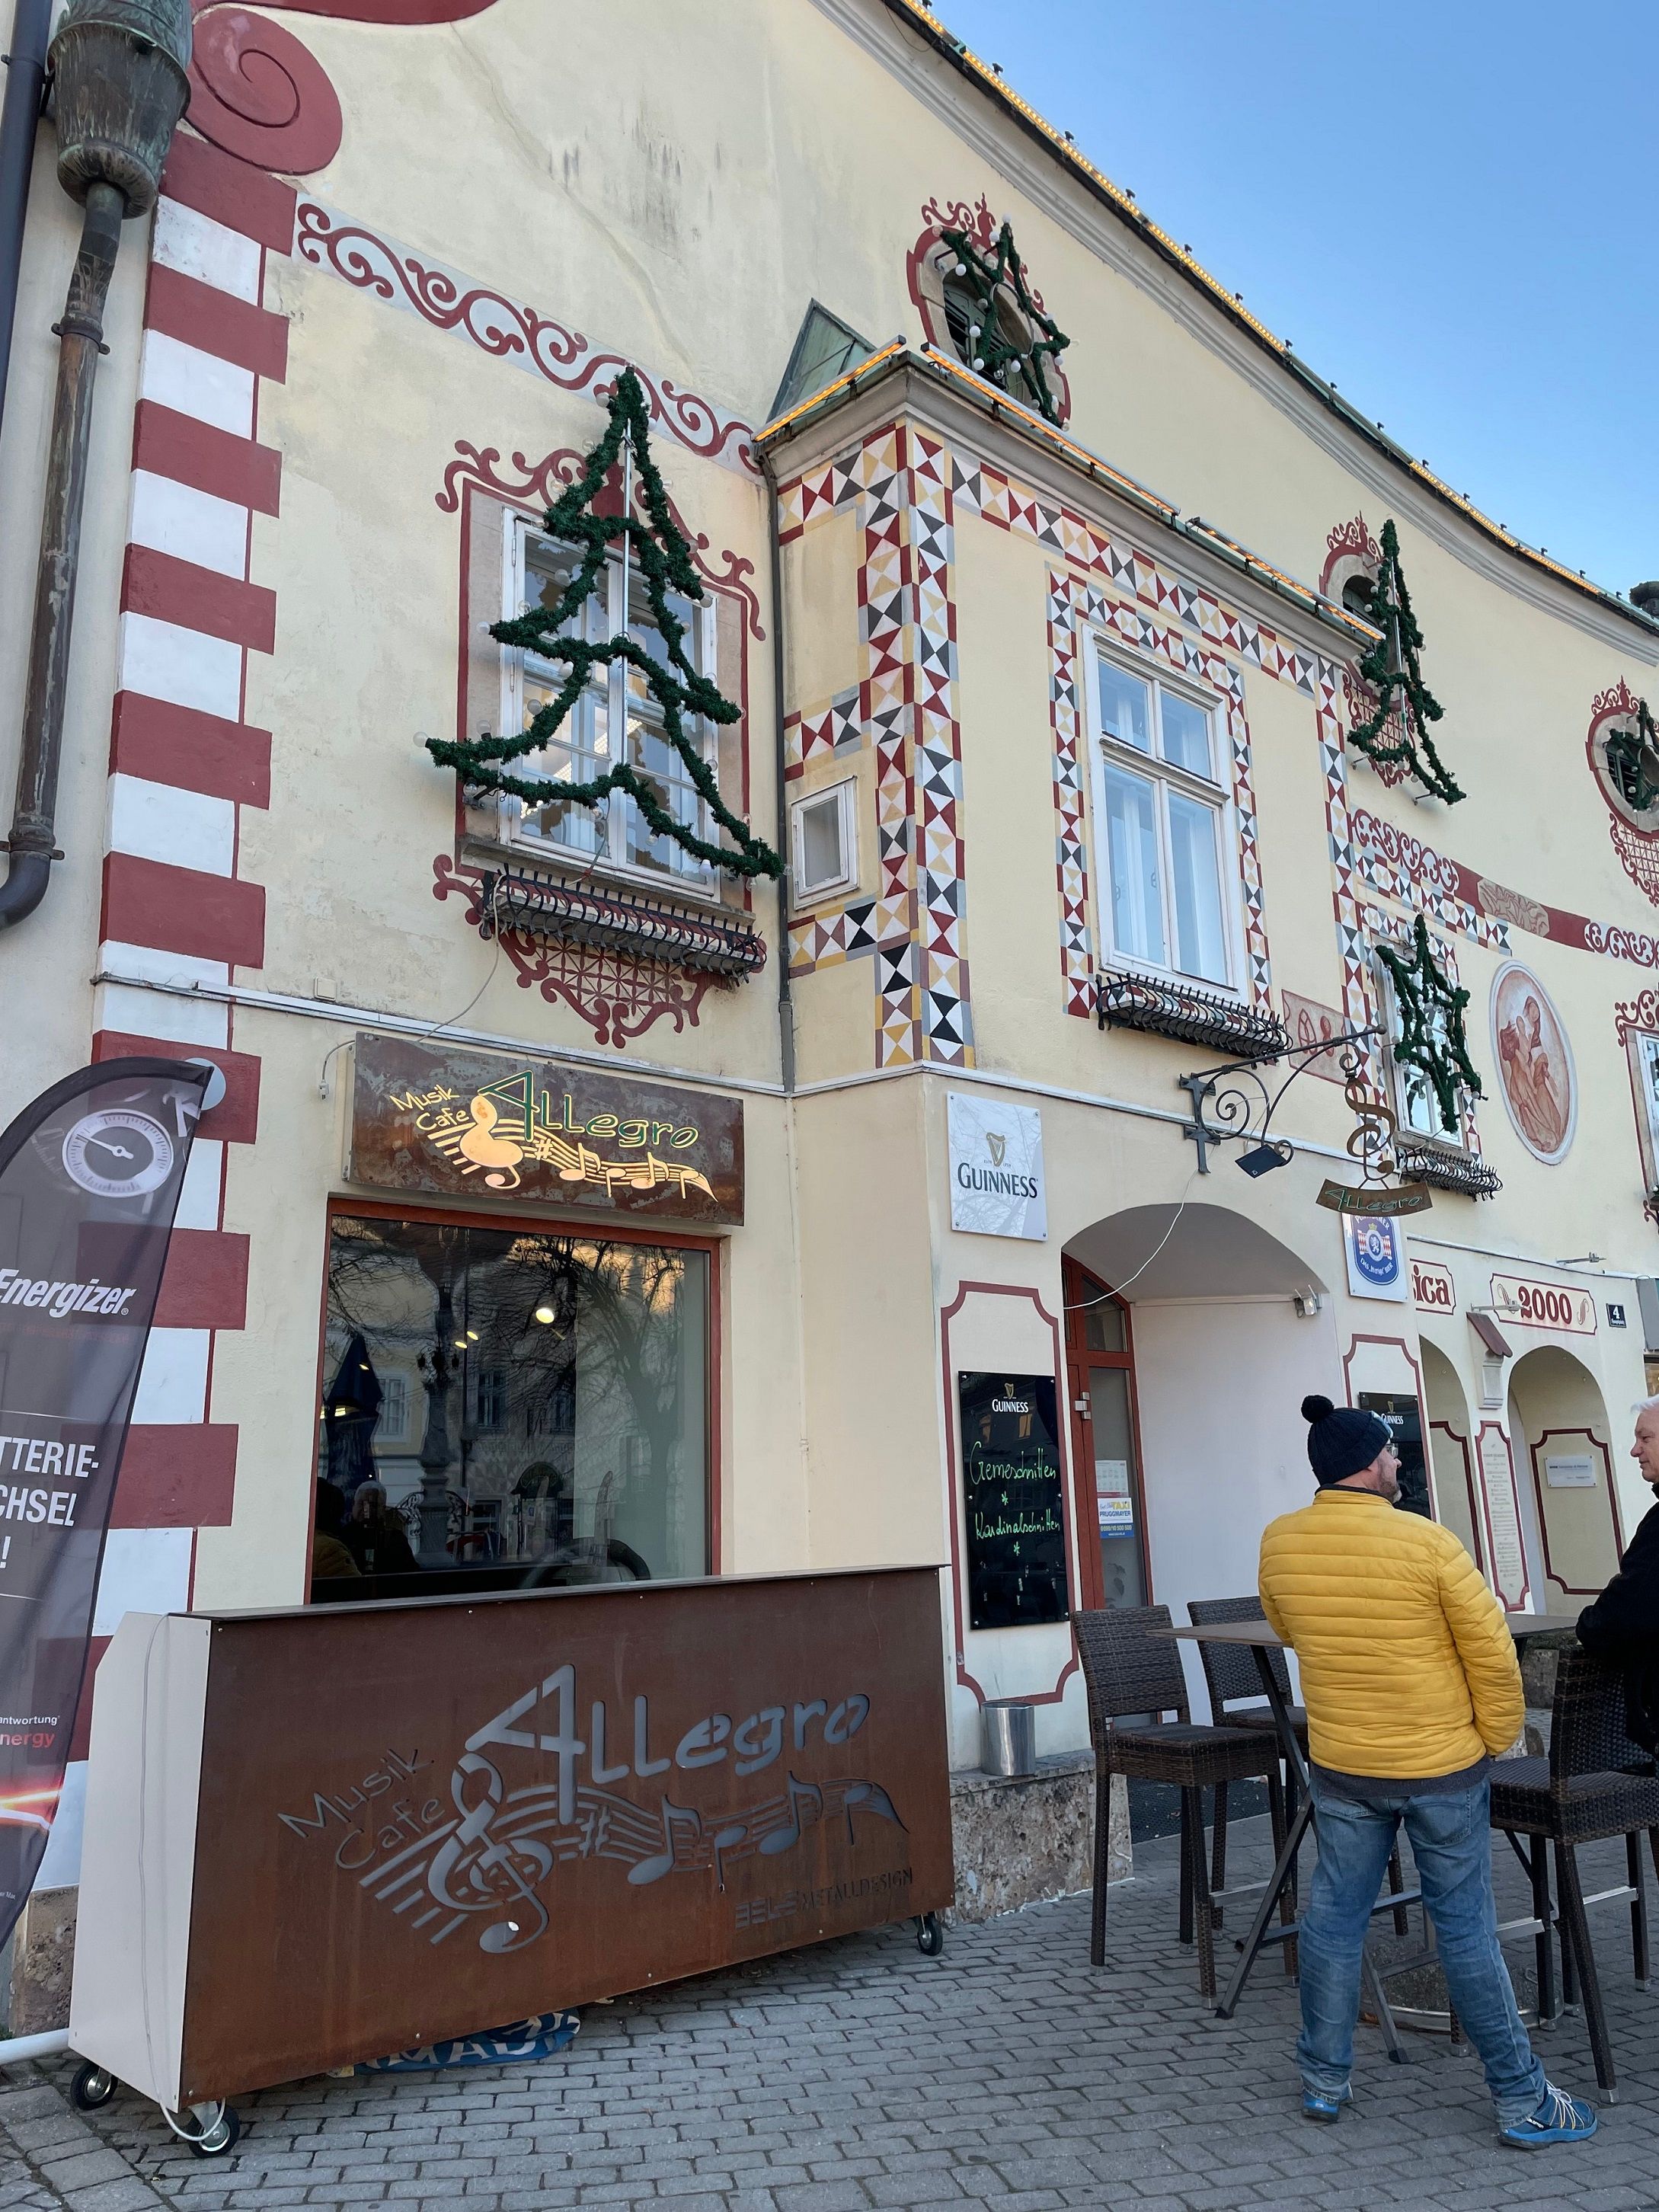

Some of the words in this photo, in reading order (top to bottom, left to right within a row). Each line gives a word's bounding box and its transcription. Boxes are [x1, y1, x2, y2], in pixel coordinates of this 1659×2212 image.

[389, 1084, 460, 1111] Musik
[416, 1108, 469, 1131] Cafe
[957, 1162, 1037, 1198] GUINNESS
[0, 1268, 137, 1319] Energizer
[1411, 1264, 1451, 1306] ica
[1518, 1286, 1572, 1325] 2000
[1613, 1306, 1620, 1319] 4
[992, 1398, 1029, 1413] GUINNESS
[277, 1748, 435, 1839] Musik
[335, 1798, 446, 1869] Cafe
[801, 1868, 913, 1910] METALLDESIGN
